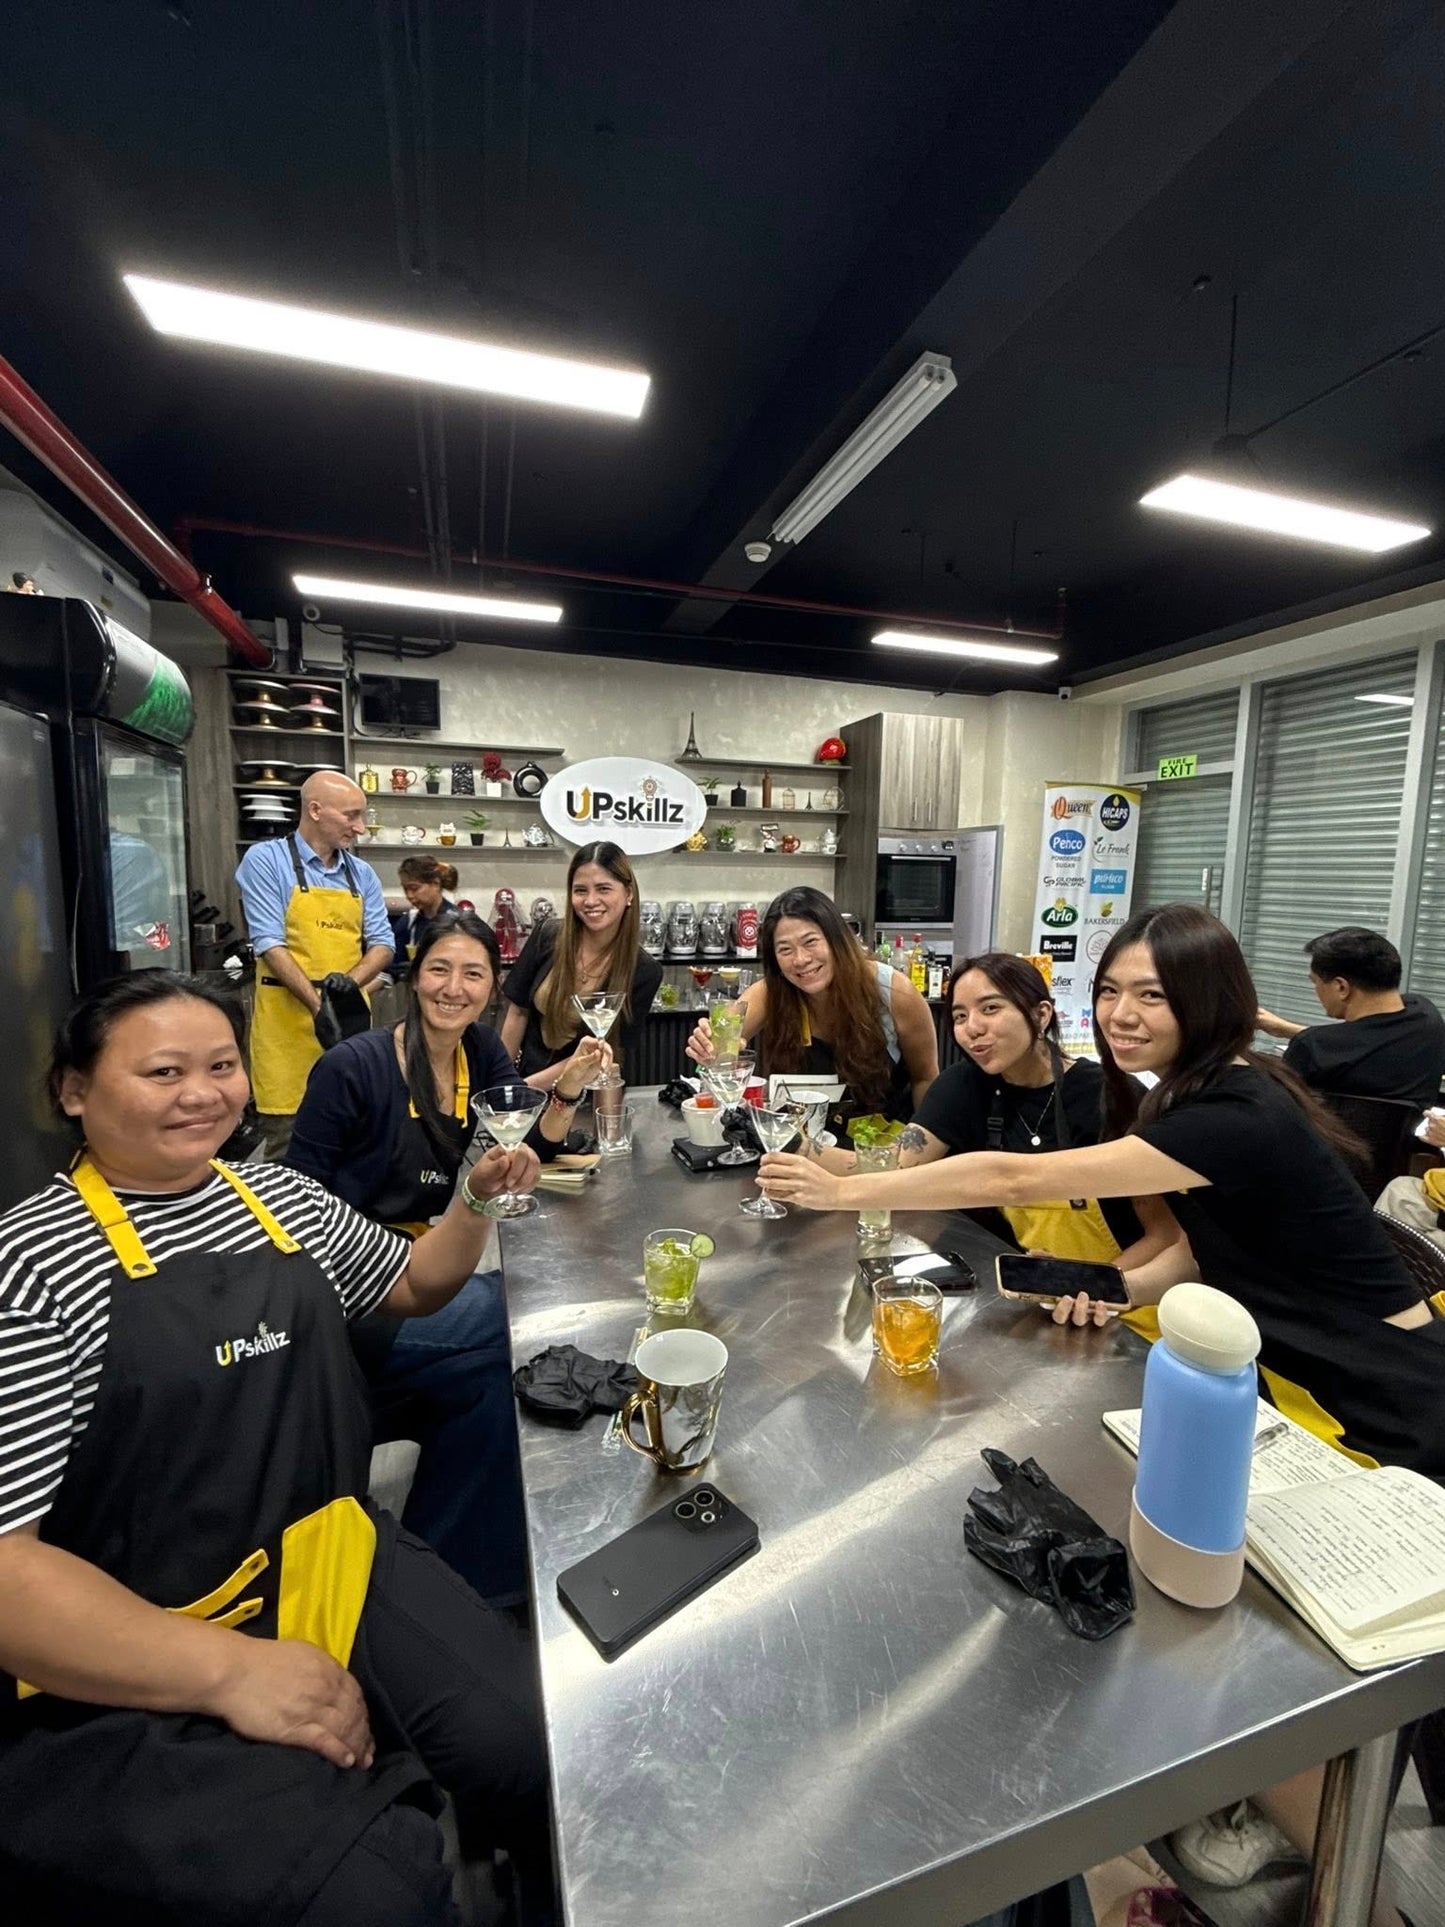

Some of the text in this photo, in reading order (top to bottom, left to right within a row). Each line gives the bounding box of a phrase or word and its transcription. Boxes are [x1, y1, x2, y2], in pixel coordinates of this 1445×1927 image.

[1161, 763, 1194, 778] EXIT
[567, 786, 684, 823] UPskillz
[1053, 796, 1089, 820] Queen
[1101, 807, 1128, 820] HICAPS
[1053, 836, 1083, 850] Penco
[1047, 909, 1073, 922] Arla
[1043, 940, 1073, 950] Breville
[215, 1331, 291, 1367] UPskillz
